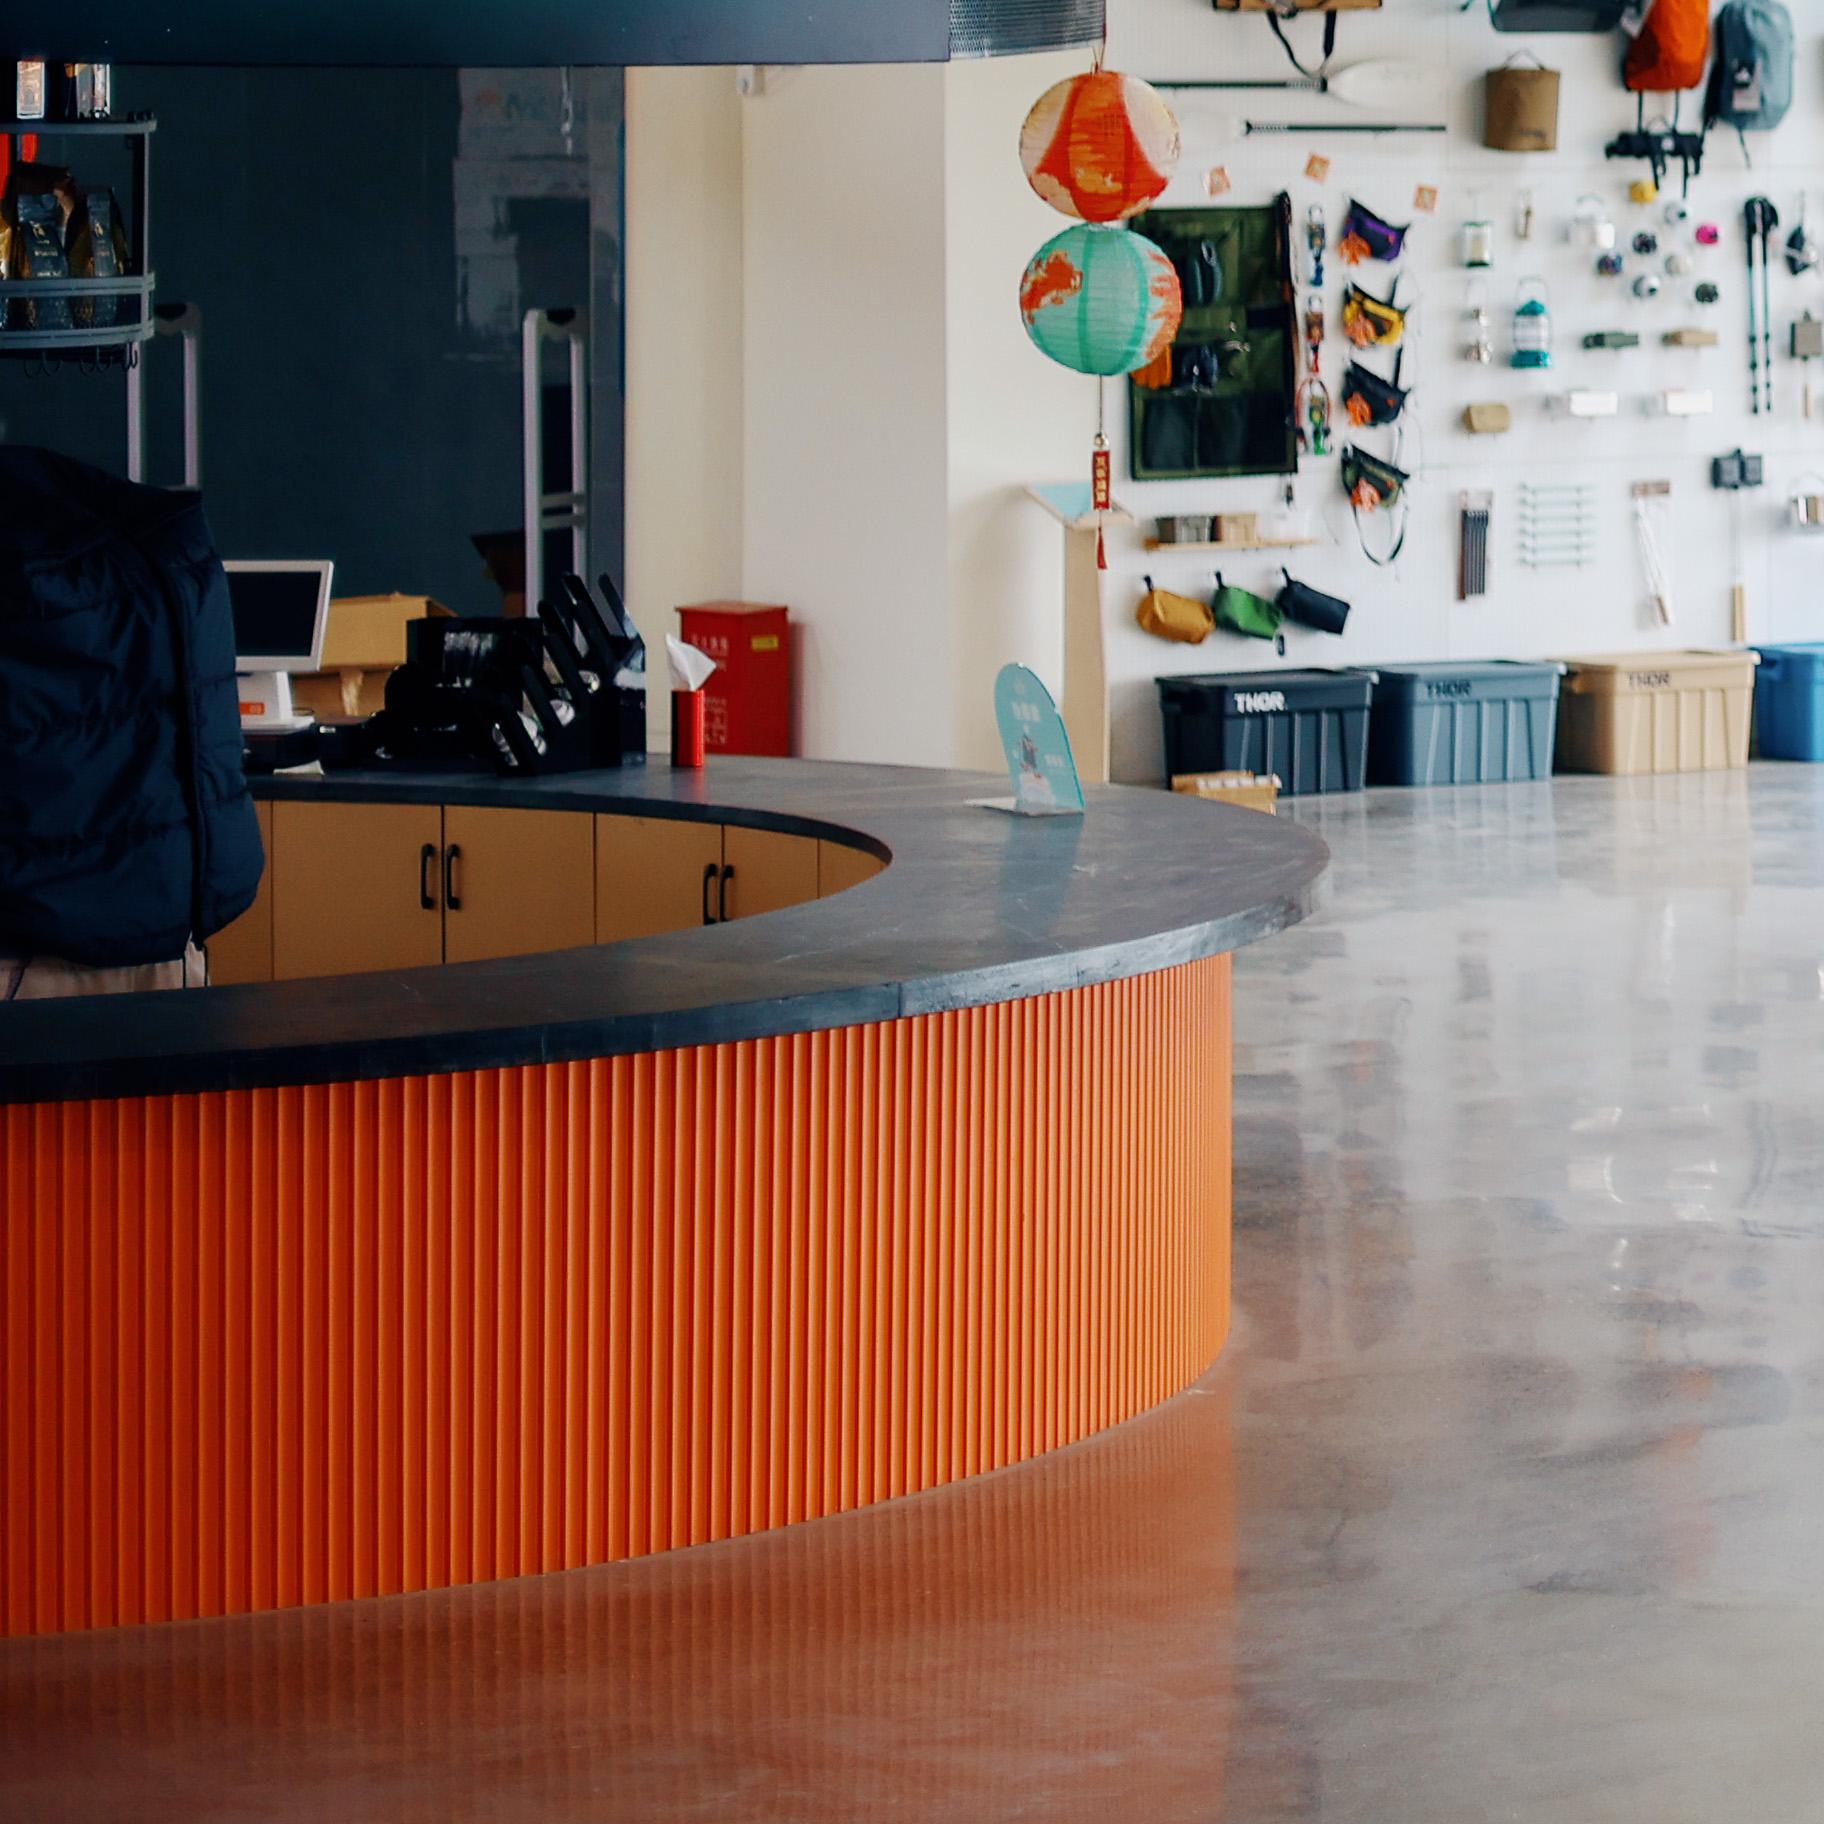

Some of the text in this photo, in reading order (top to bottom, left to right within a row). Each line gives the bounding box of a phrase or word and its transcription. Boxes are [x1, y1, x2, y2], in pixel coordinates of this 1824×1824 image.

[1427, 679, 1472, 698] THOR
[1627, 671, 1671, 688] THOR
[1233, 691, 1286, 713] THOR
